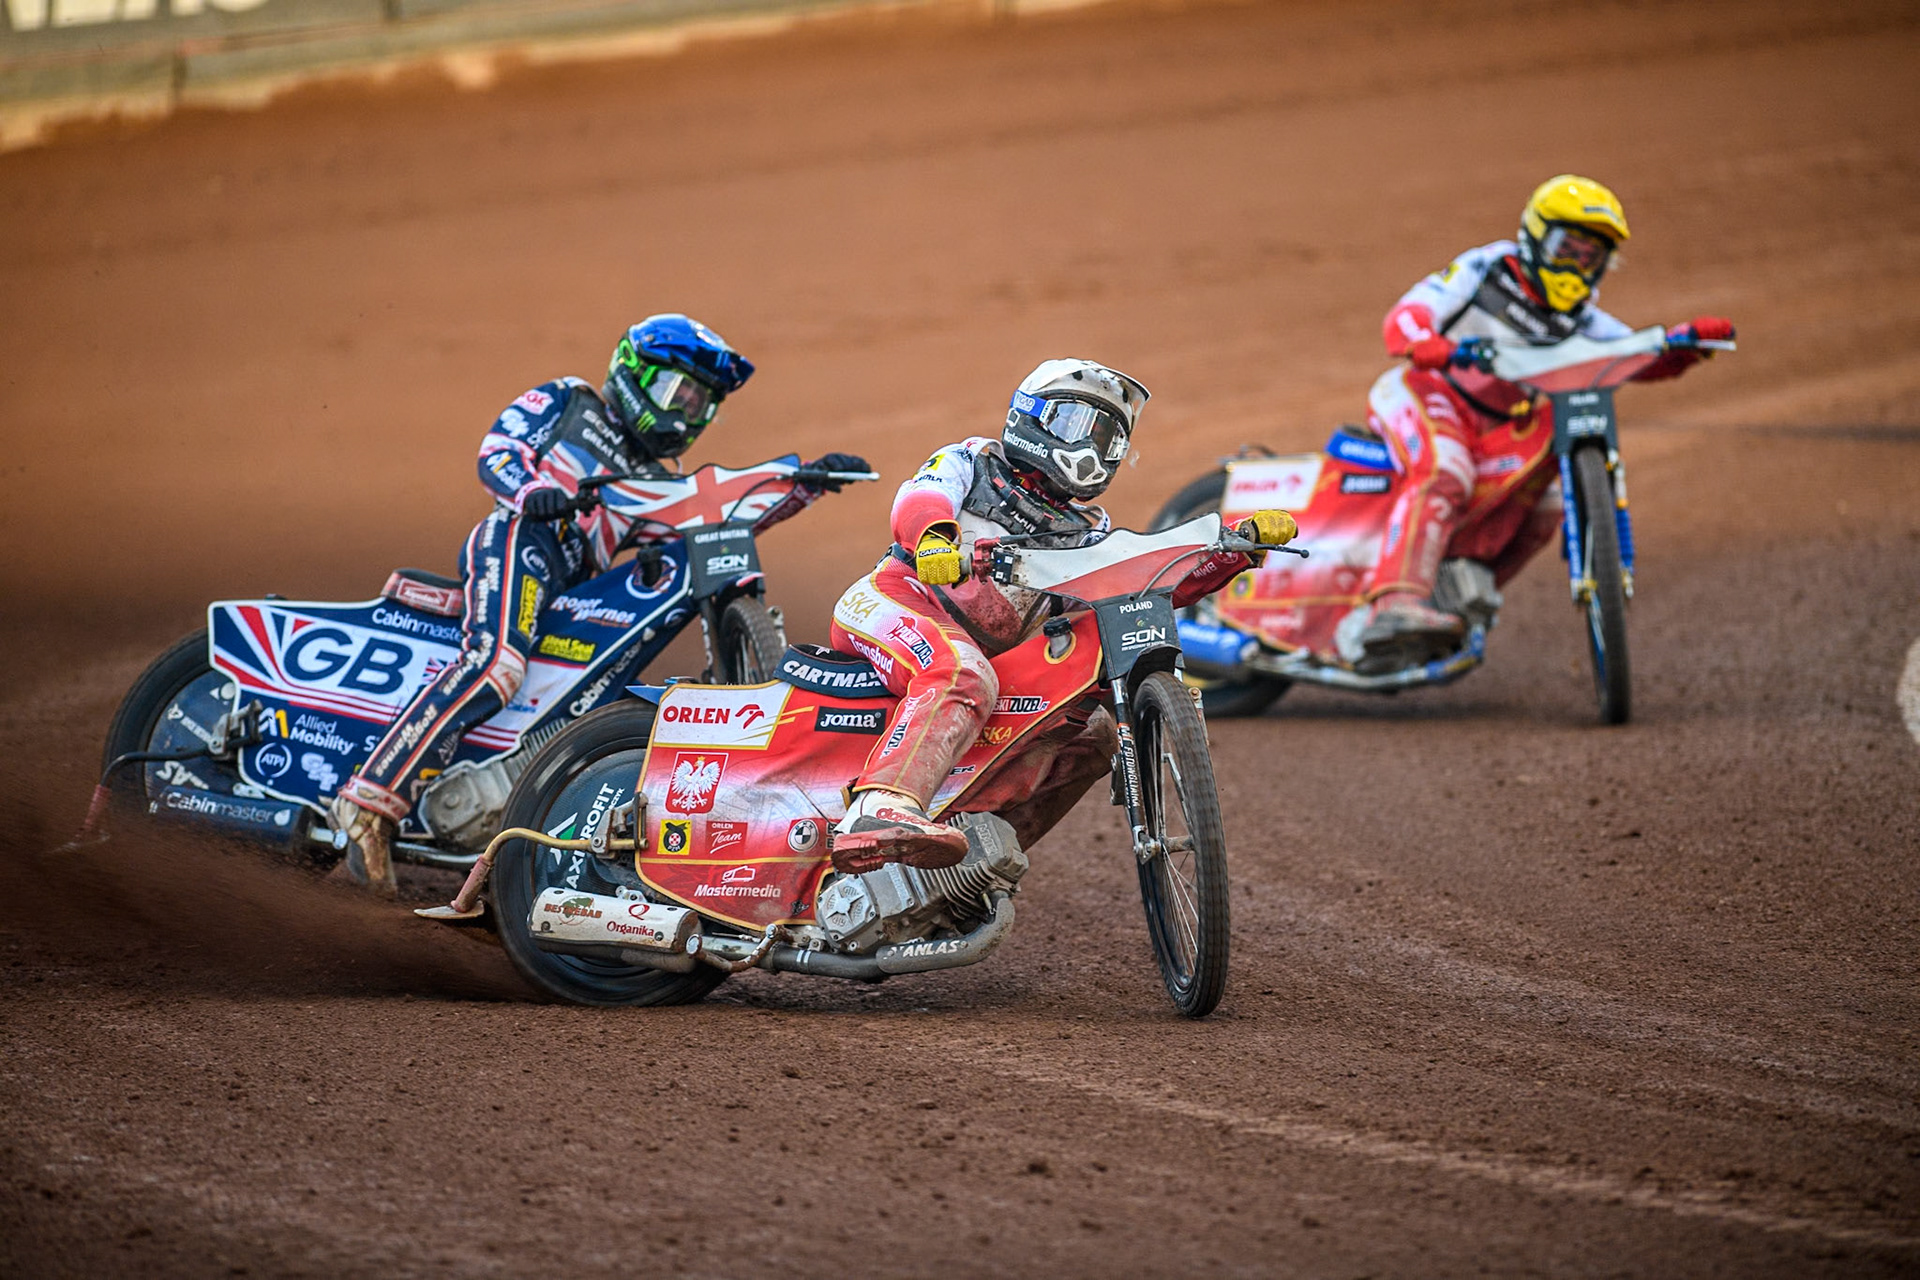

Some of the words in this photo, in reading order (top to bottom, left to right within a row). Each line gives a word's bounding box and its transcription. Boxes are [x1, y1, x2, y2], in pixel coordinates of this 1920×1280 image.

[582, 409, 624, 445] SON
[707, 553, 749, 571] SON
[550, 595, 603, 613] Roger
[1119, 600, 1153, 614] POLAND
[372, 607, 462, 643] Cabinmaste
[572, 607, 637, 623] Warnes
[1121, 627, 1166, 647] SON
[283, 627, 413, 694] GB
[847, 633, 894, 675] Transbud
[295, 713, 337, 735] Allied
[662, 705, 730, 725] ORLEN
[290, 725, 354, 756] Mobility
[260, 752, 286, 768] ATPI
[166, 791, 275, 823] Cabinmaster
[566, 782, 615, 890] AXIROFIT
[711, 830, 742, 847] Team
[694, 884, 781, 899] Mastermedia
[606, 920, 655, 937] Organika
[903, 939, 960, 958] ANLAS
